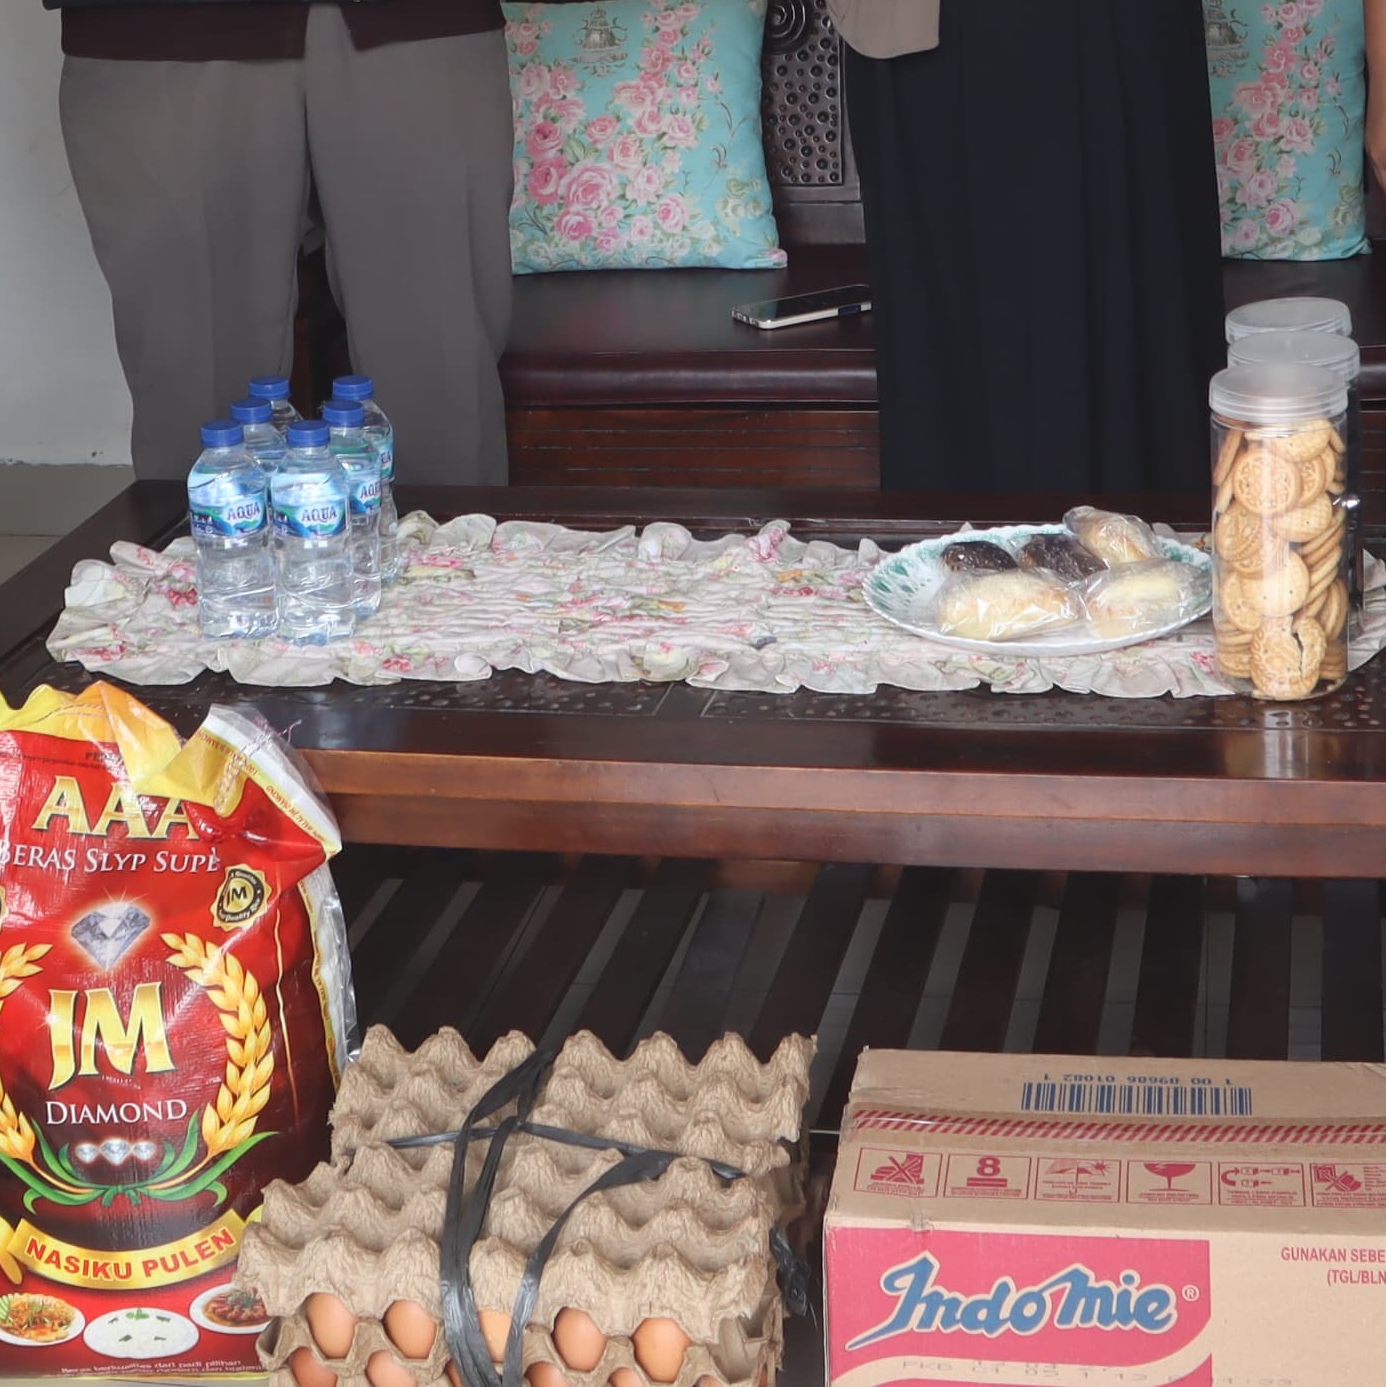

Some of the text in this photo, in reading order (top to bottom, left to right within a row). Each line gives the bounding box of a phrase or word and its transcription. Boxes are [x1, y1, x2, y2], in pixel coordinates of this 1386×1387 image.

[359, 481, 381, 499] AQU
[226, 502, 261, 522] AQUA
[301, 506, 338, 523] AQUA
[31, 776, 201, 841] AAA
[84, 847, 146, 873] SLYP
[153, 848, 220, 873] SUPE
[47, 982, 177, 1092] JM
[976, 1156, 1001, 1176] 8
[25, 1228, 237, 1281] NASIKU PULEN
[1281, 1247, 1347, 1262] GUNAKAN
